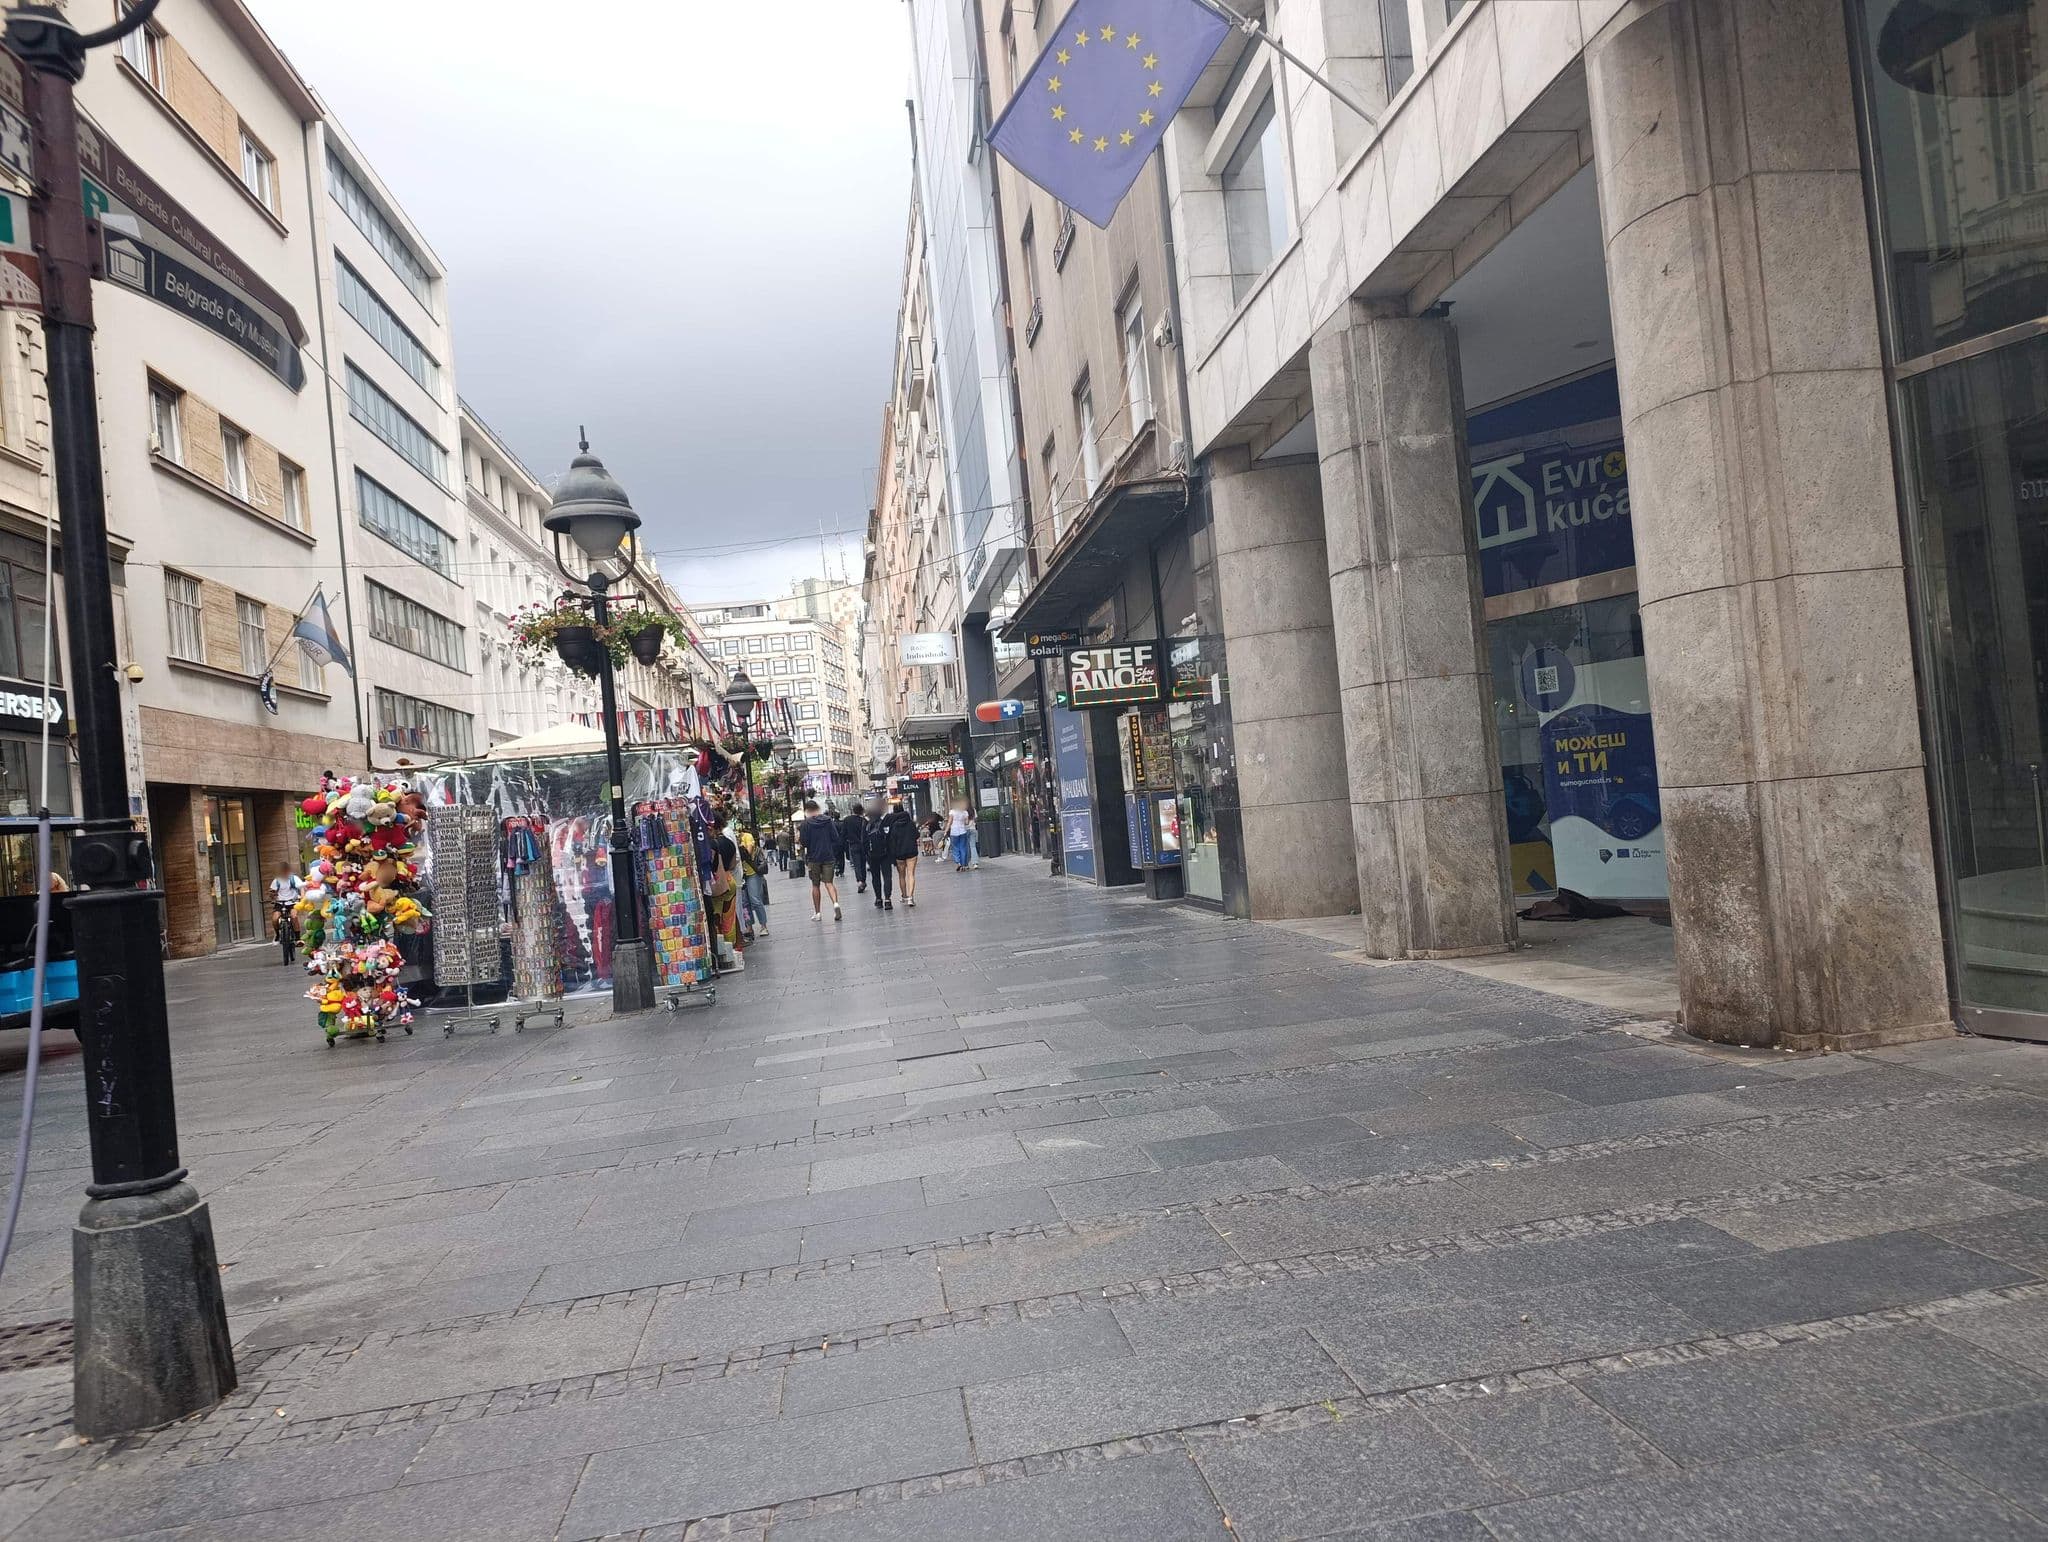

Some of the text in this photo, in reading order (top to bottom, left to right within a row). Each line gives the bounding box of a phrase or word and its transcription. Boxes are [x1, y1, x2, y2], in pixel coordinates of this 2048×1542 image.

[116, 166, 246, 288] Belgrade Cultural Centre
[165, 271, 280, 359] Belgrade City Museum
[1040, 632, 1077, 643] megaSun
[1070, 646, 1153, 672] STEF
[1072, 667, 1136, 690] ANO
[1555, 732, 1626, 752] МОЖЕШ
[1573, 751, 1608, 773] ТИ
